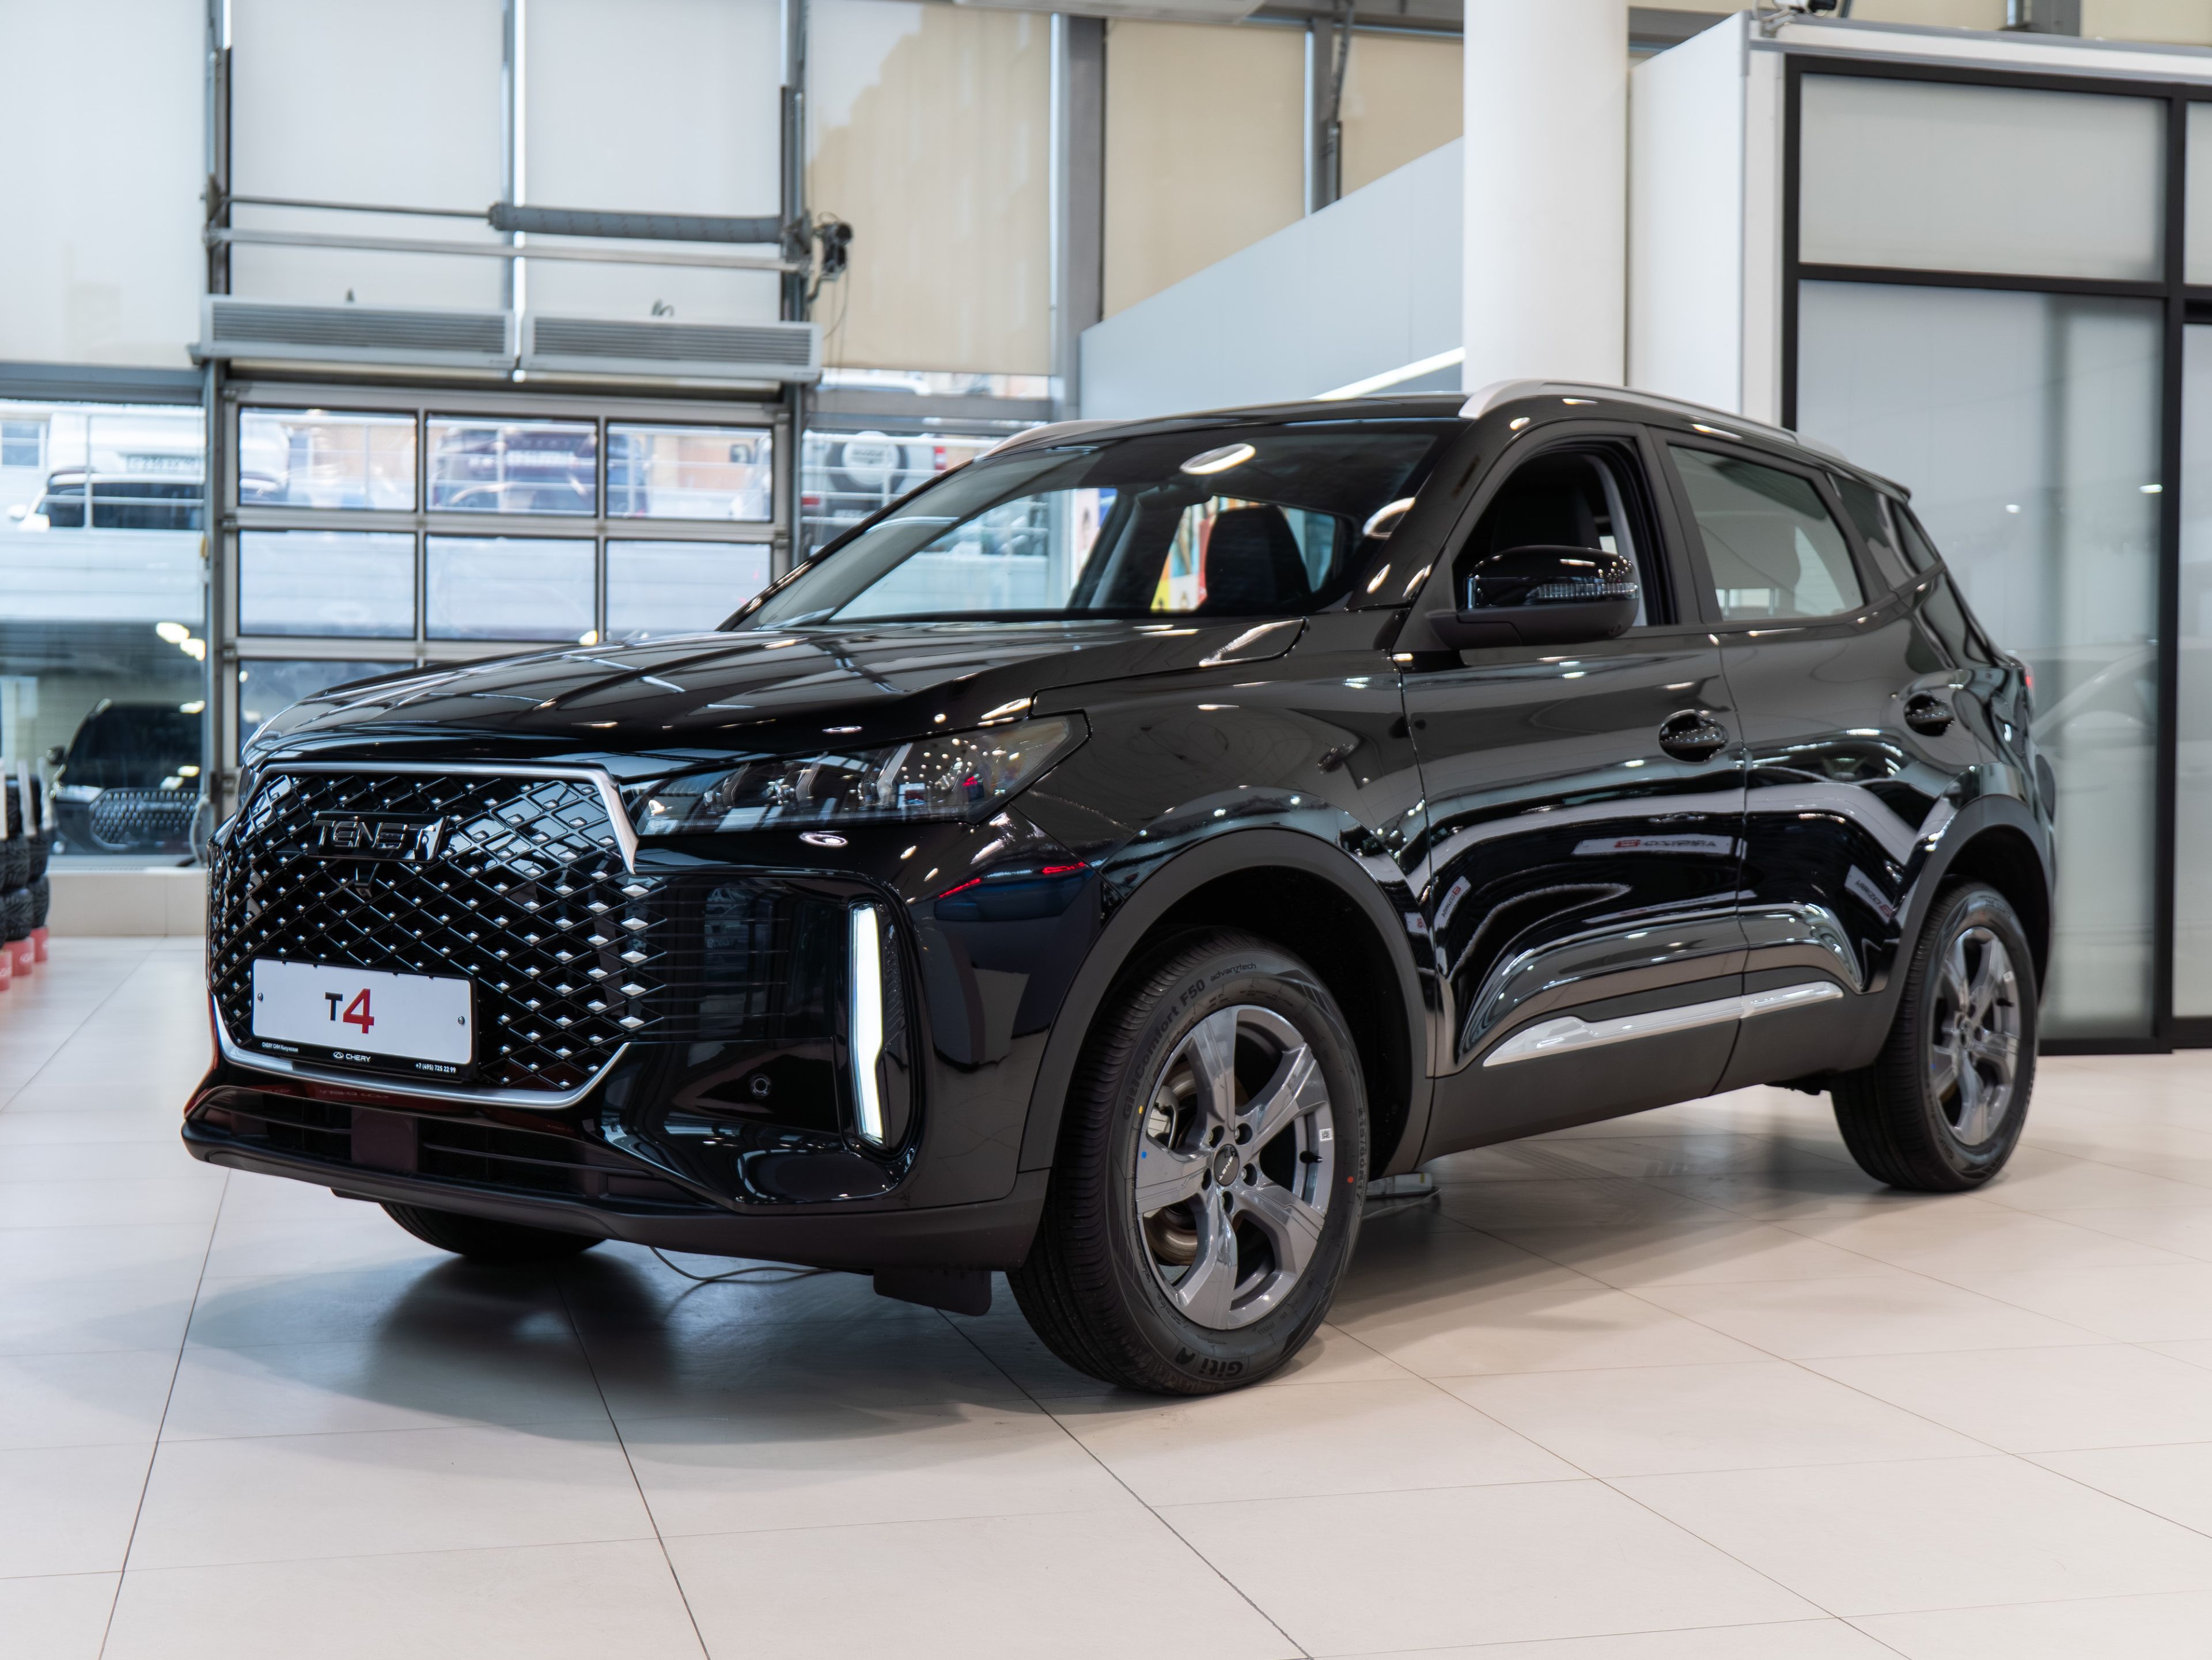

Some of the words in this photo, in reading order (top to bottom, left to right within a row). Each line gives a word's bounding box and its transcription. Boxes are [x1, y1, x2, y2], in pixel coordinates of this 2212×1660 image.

[315, 819, 436, 850] TENET
[1179, 979, 1206, 1007] F50
[1210, 962, 1257, 982] advanztech
[325, 988, 374, 1034] T4
[346, 1053, 371, 1062] CHERY
[1198, 1357, 1244, 1377] Giti
